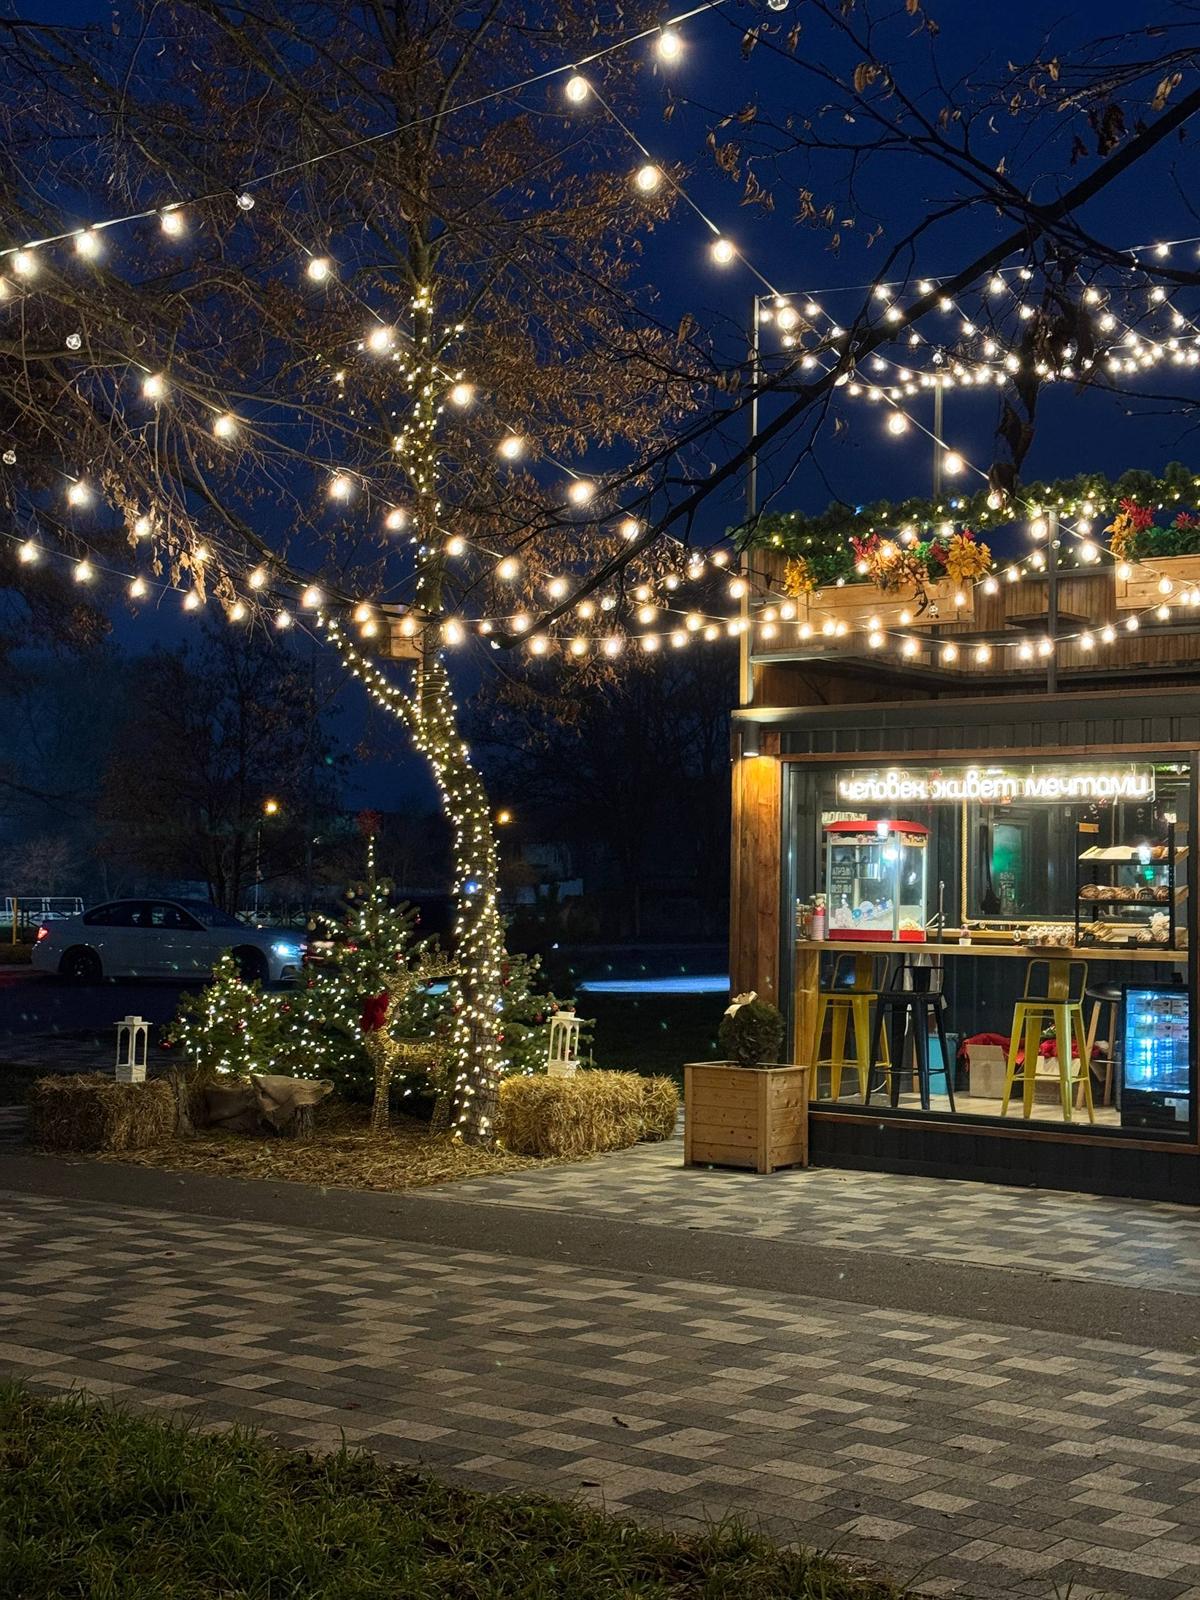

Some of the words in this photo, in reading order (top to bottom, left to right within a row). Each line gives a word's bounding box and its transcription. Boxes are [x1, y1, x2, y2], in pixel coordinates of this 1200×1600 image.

[839, 771, 929, 799] человек
[930, 769, 1016, 799] живет
[1024, 776, 1149, 796] мечтами
